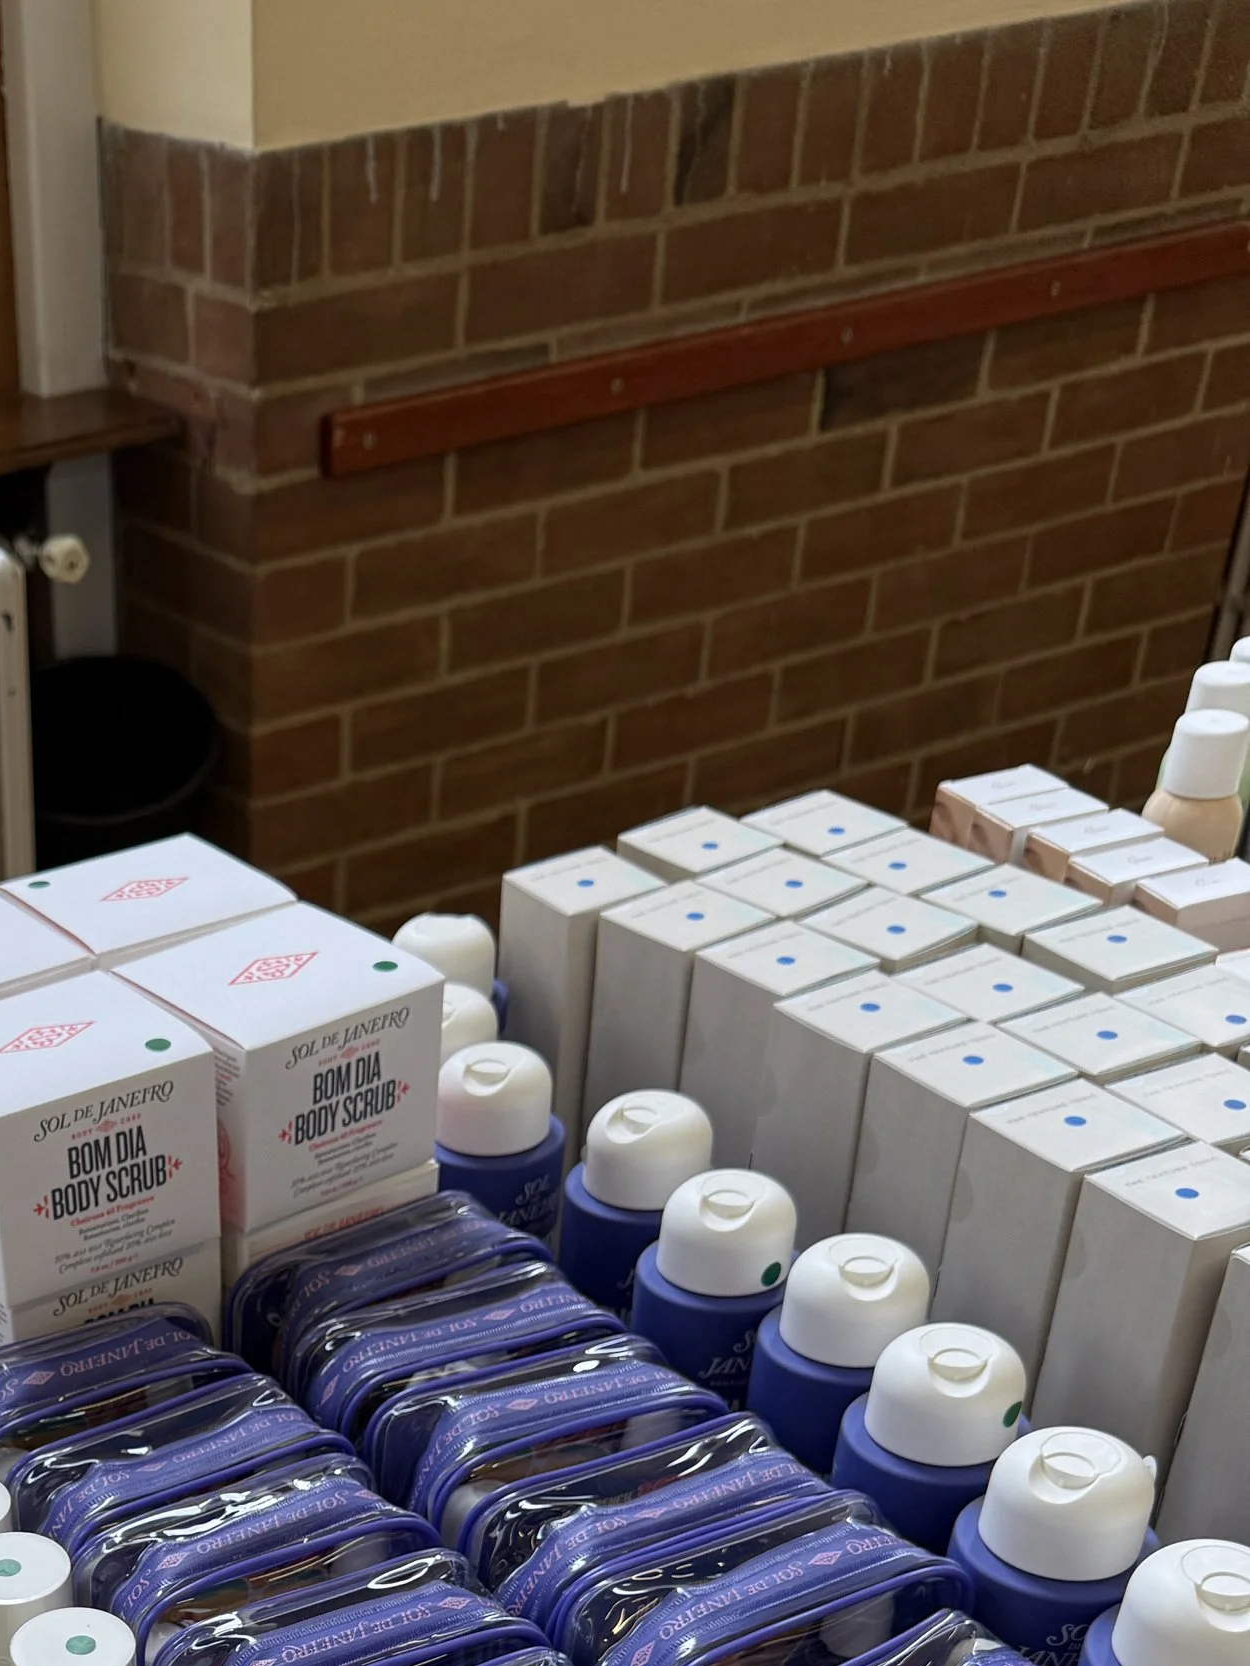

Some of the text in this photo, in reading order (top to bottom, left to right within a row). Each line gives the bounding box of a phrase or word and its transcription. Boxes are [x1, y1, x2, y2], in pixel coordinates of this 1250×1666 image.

[285, 1007, 410, 1070] SOL JANEIRO
[312, 1051, 381, 1105] BOM DIA
[33, 1080, 174, 1143] SOL DE JANEIRO
[294, 1100, 339, 1146] BODY
[342, 1079, 396, 1128] SCRUB
[67, 1125, 147, 1180] BOM DIA
[51, 1153, 167, 1221] BODY SCRUB
[53, 1288, 89, 1317] SOL
[90, 1280, 108, 1299] DE
[108, 1256, 184, 1299] JANEIRO
[60, 1336, 167, 1377] DE JANEIRO
[543, 1376, 627, 1404] JANEIRO
[104, 1470, 130, 1487] SOL
[672, 1470, 757, 1510] JANEIRO
[196, 1488, 349, 1554] SOL DE JANEIRO
[658, 1560, 805, 1642] SOL DE JANEIRO
[281, 1601, 433, 1664] SOL DE JANEIRO
